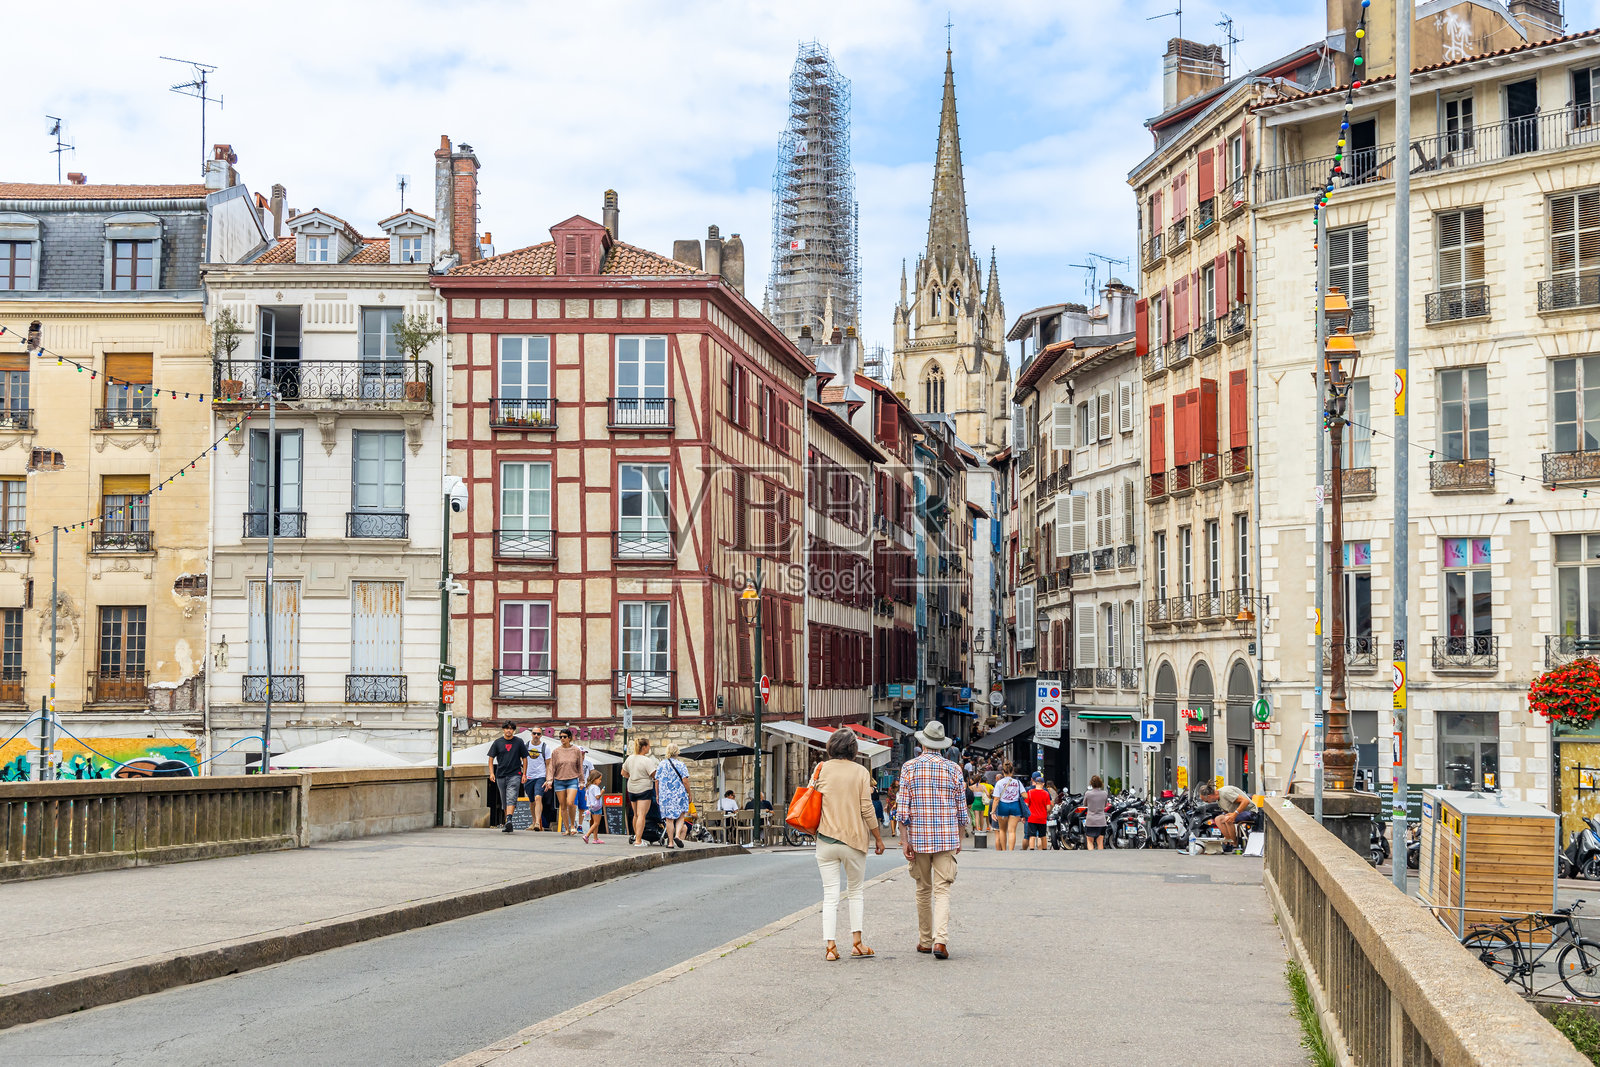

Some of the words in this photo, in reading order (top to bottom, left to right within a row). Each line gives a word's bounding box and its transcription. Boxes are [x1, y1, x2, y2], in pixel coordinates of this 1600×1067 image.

[1181, 709, 1198, 719] SPAR
[568, 727, 618, 740] REMY
[1146, 724, 1157, 738] P
